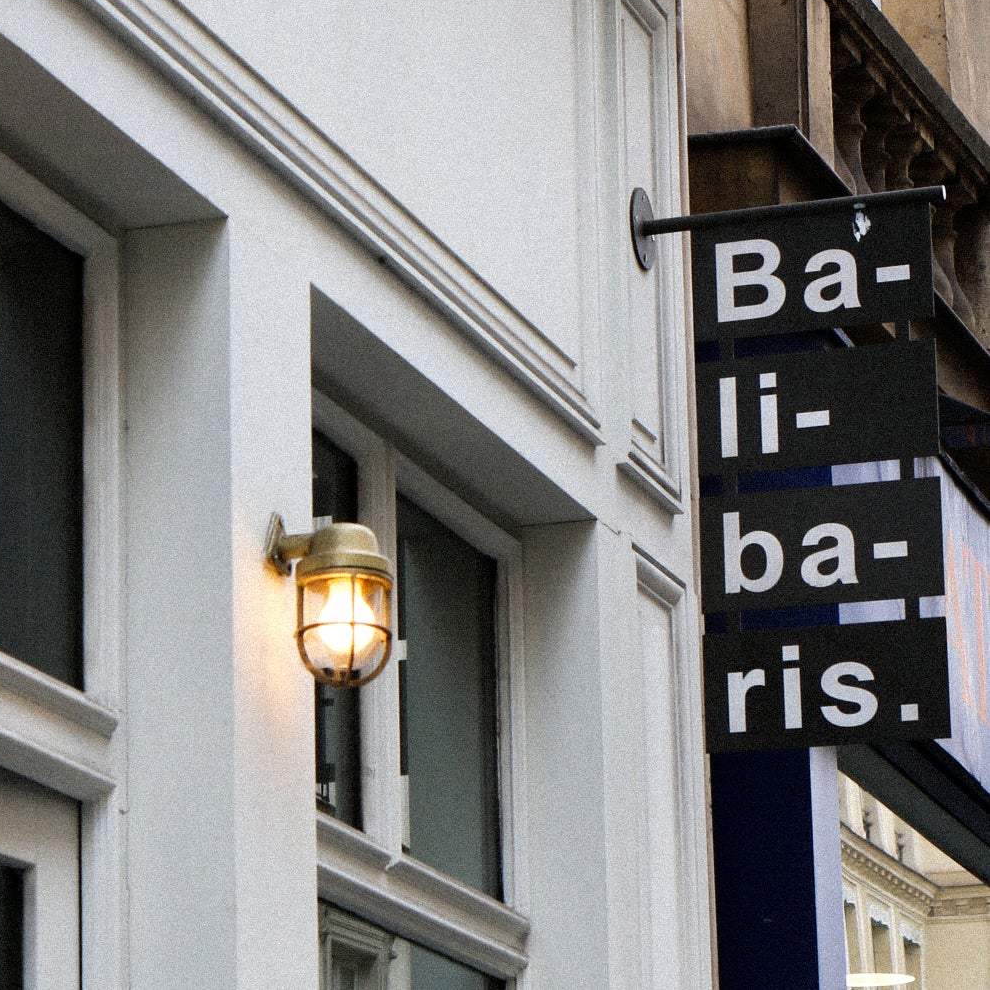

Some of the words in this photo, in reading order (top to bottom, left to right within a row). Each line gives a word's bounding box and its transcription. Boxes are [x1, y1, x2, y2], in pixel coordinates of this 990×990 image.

[715, 238, 910, 323] Ba-
[719, 373, 830, 458] li-
[723, 512, 908, 594] ba-
[727, 646, 919, 733] ris.
